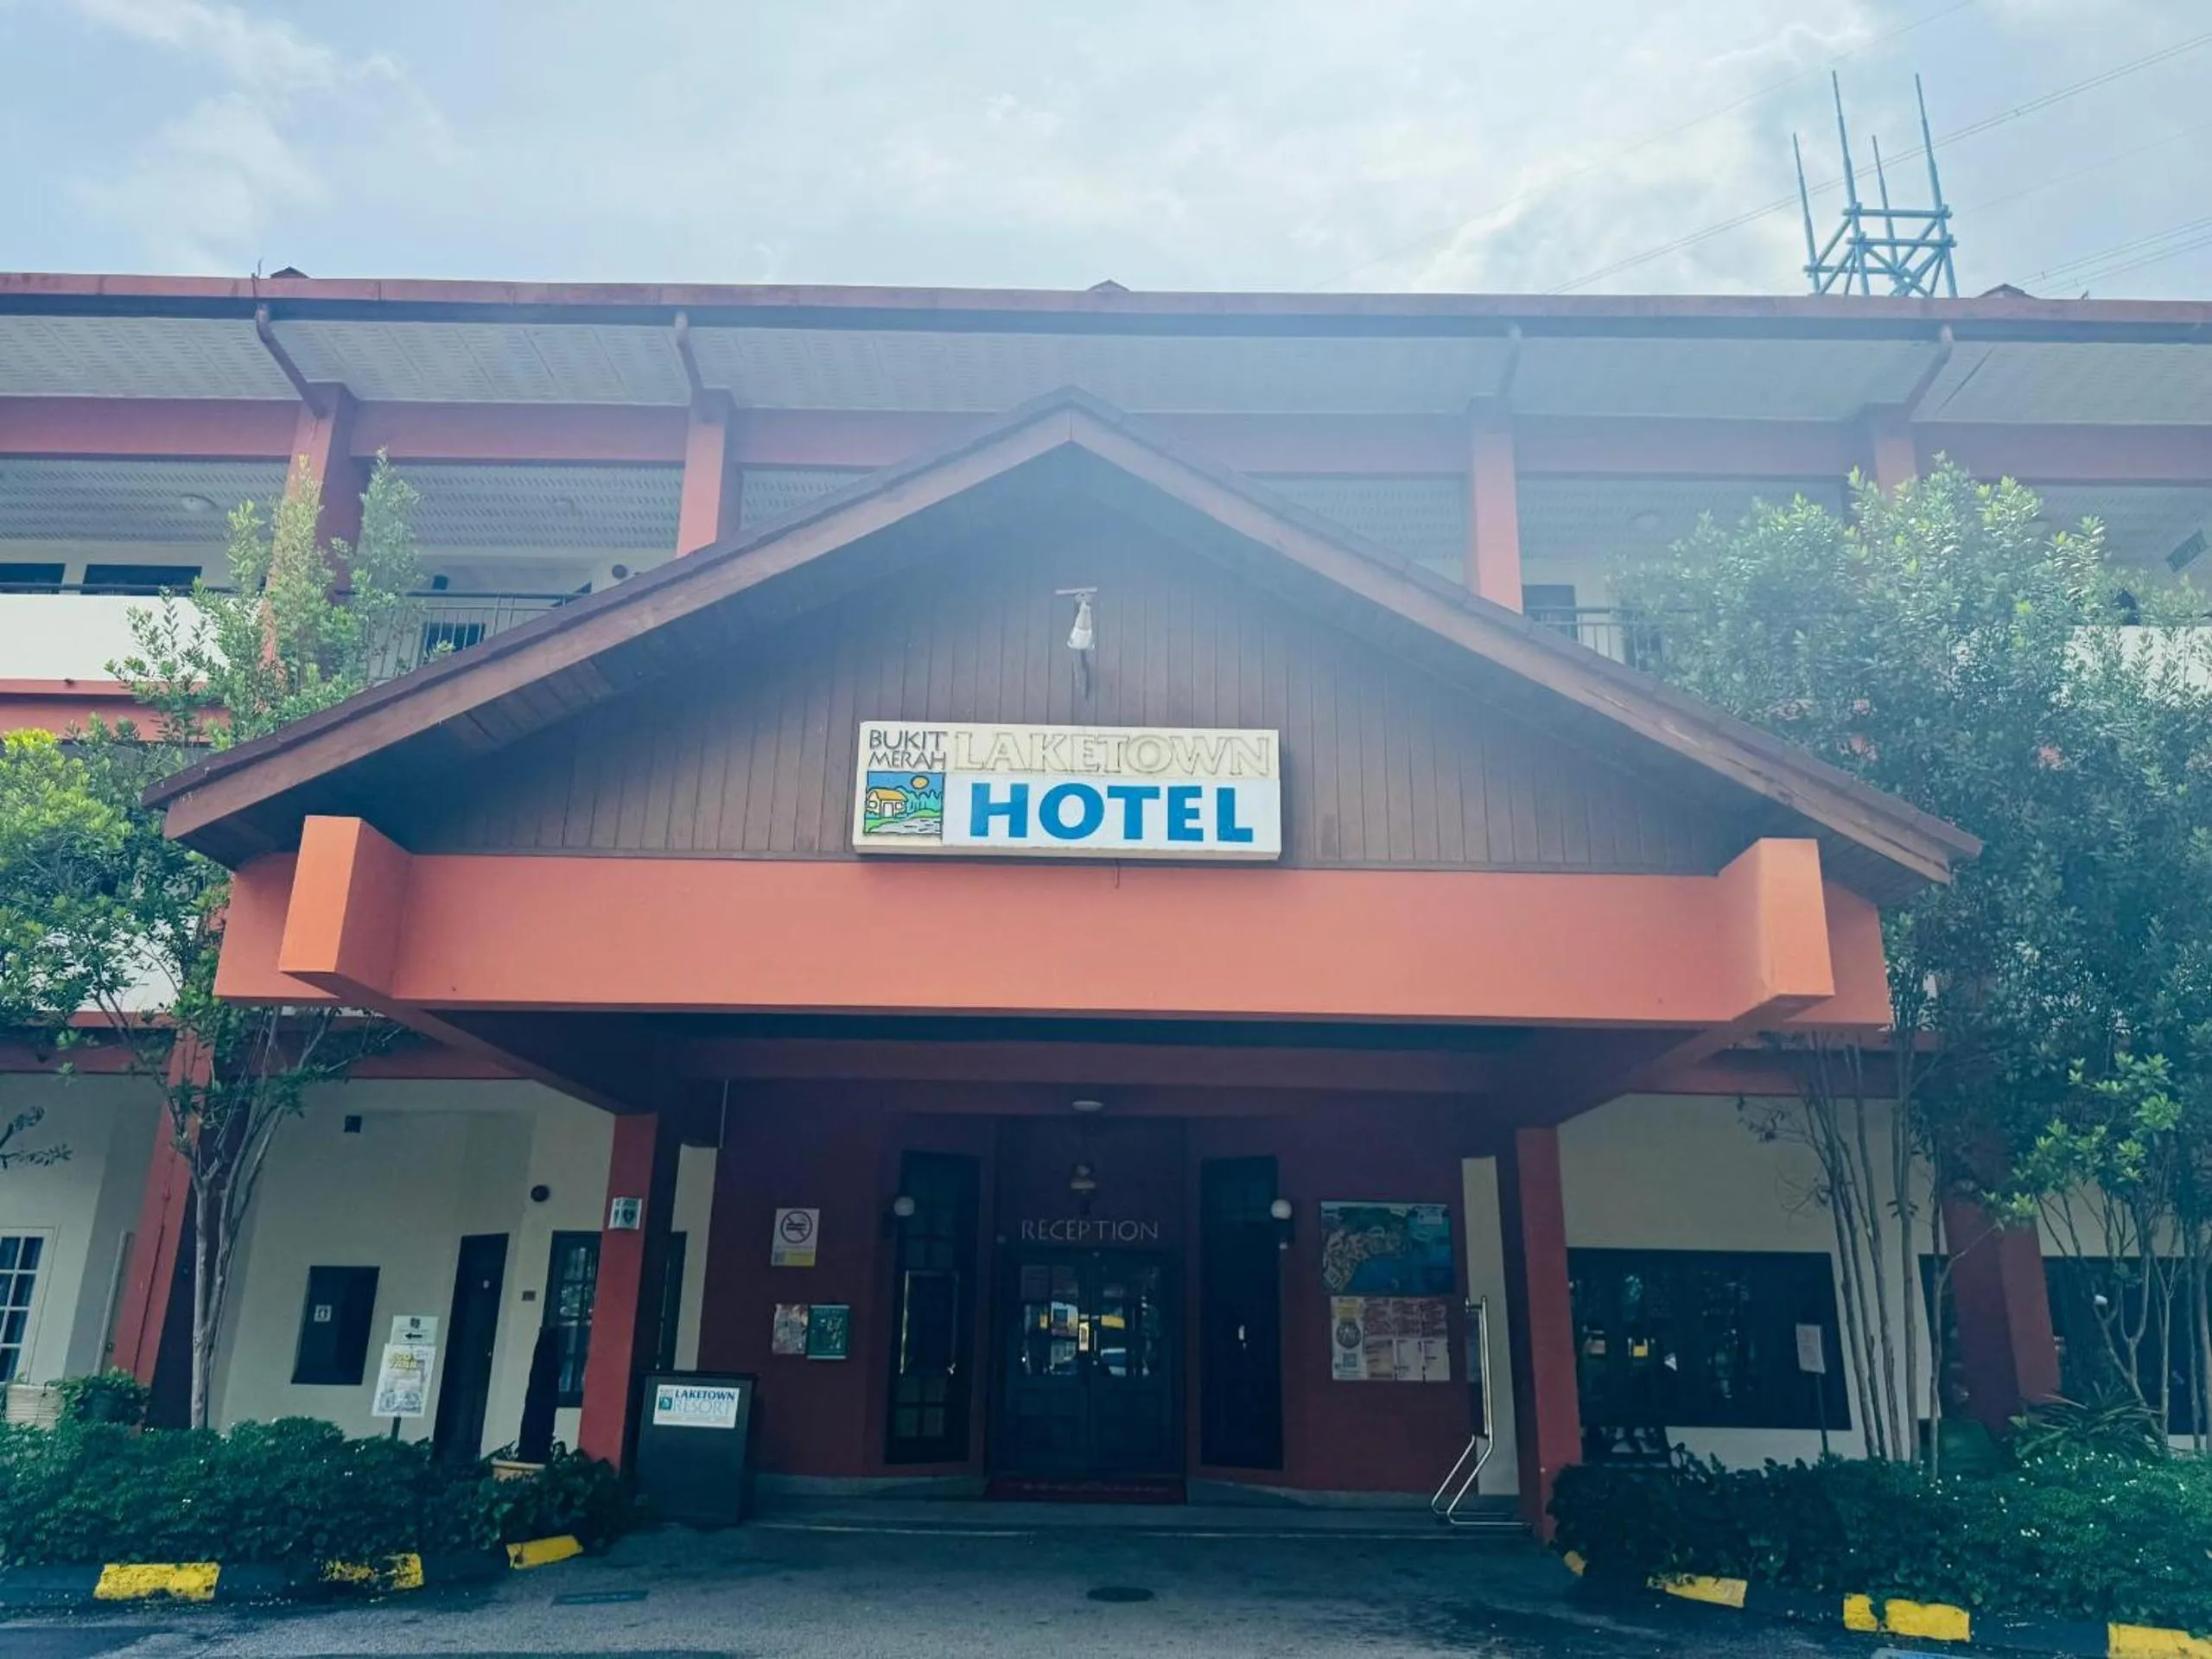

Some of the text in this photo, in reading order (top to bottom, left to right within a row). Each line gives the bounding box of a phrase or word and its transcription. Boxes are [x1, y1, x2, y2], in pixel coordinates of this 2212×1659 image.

[869, 729, 947, 751] BUKIT
[868, 750, 947, 770] MERAH
[954, 731, 1269, 777] LAKETOWN
[969, 782, 1254, 843] HOTEL
[1020, 1218, 1160, 1242] RECEPTION
[675, 1389, 735, 1402] LAKETOWN
[674, 1400, 729, 1416] RESORT
